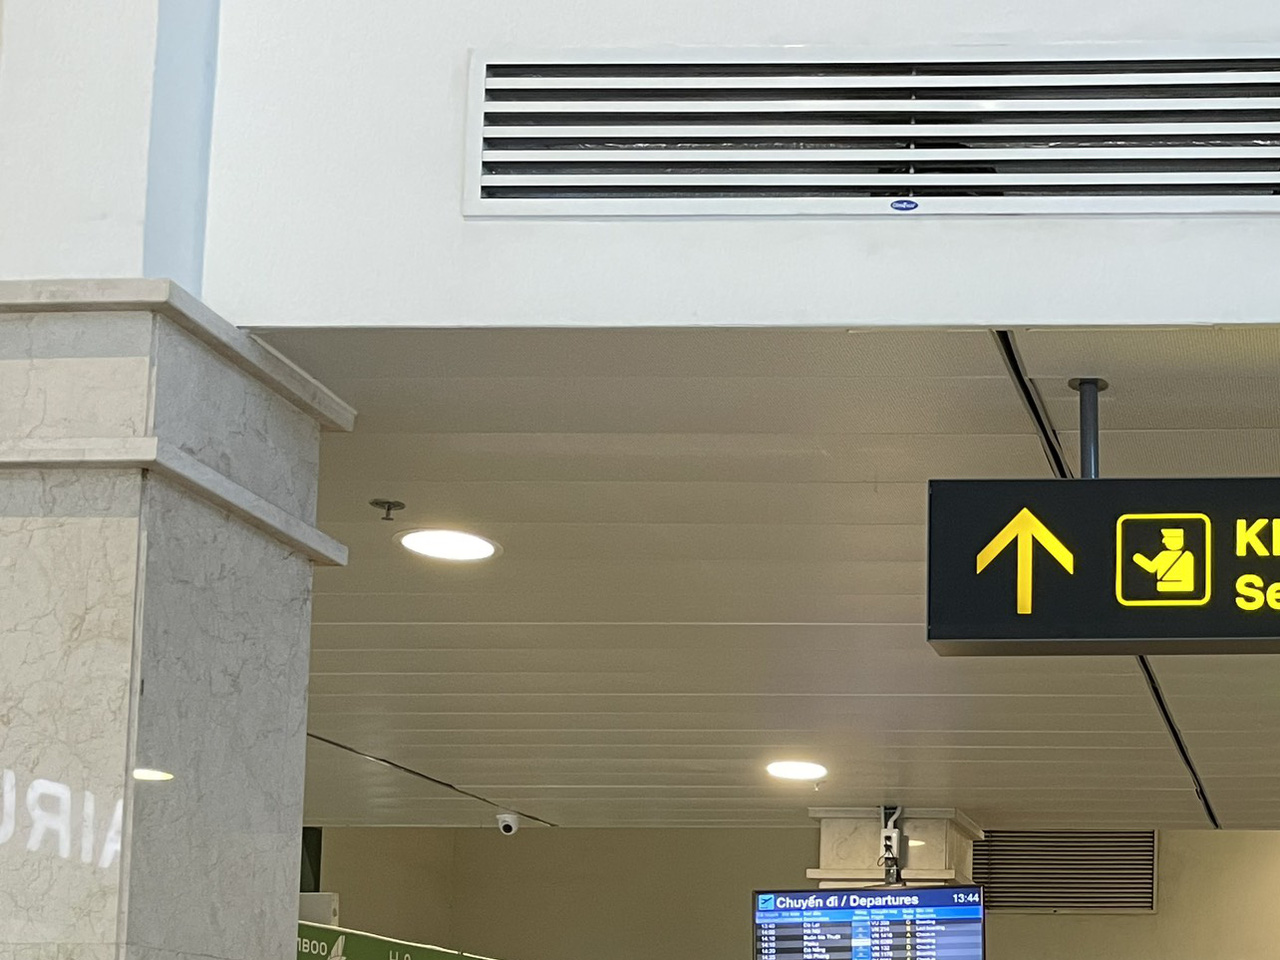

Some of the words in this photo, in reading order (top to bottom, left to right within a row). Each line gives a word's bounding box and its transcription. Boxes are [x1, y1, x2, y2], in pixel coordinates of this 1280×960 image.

[777, 895, 823, 910] Chuyến
[850, 895, 919, 909] Departures
[953, 893, 980, 904] 13:44
